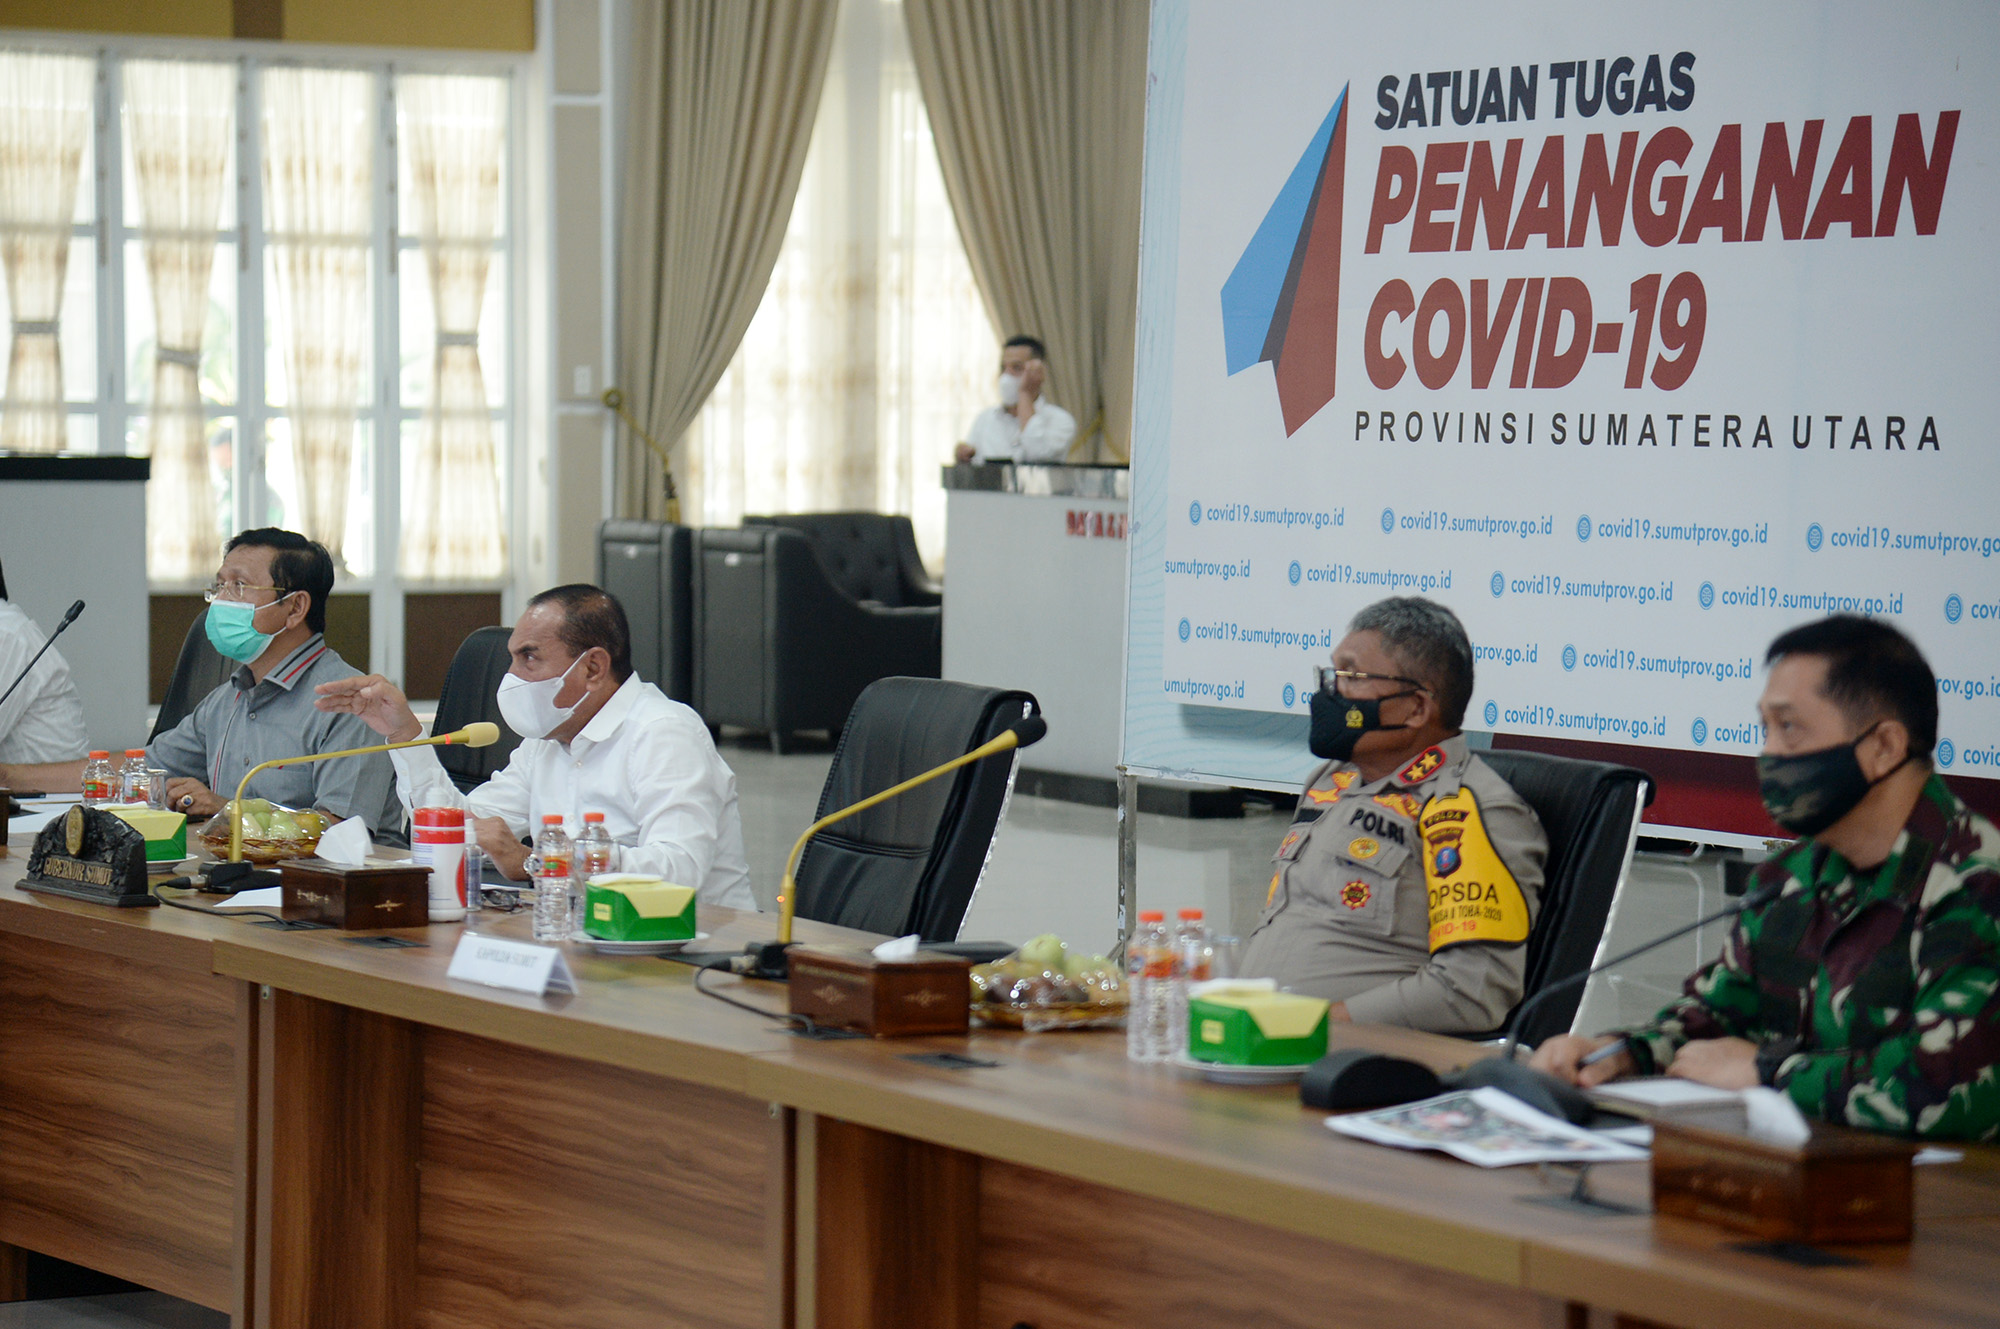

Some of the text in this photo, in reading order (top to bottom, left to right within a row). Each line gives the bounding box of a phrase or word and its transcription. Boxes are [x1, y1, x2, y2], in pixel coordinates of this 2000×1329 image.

[1375, 51, 1697, 130] SATUAN TUGAS
[1364, 110, 1961, 254] PENANGANAN
[1363, 271, 1707, 391] COVID-19
[1355, 411, 1941, 451] PROVINSI SUMATERA UTARA
[1206, 504, 1345, 530] covid19.sumutprov.go.id
[1400, 511, 1553, 539] covid19.sumutprov.go.id
[1598, 517, 1768, 548] covid19.sumutprov.go.id
[1164, 558, 1251, 581] sumutprov.go.id
[1306, 564, 1452, 593] covid19.sumutprov.go.id
[1511, 575, 1674, 605] covid19.sumutprov.go.id
[1721, 585, 1904, 617] covid19.sumutprov.go.id
[1195, 623, 1332, 650] covid19.sumutprov.go.id
[1583, 648, 1752, 683] covid19.sumutprov.go.id
[1163, 679, 1245, 702] umutprov.go.id
[1504, 704, 1667, 739] covid19.sumutprov.go.id
[1348, 807, 1405, 846] POLRI
[43, 856, 114, 887] GUBERNUR SUMUT
